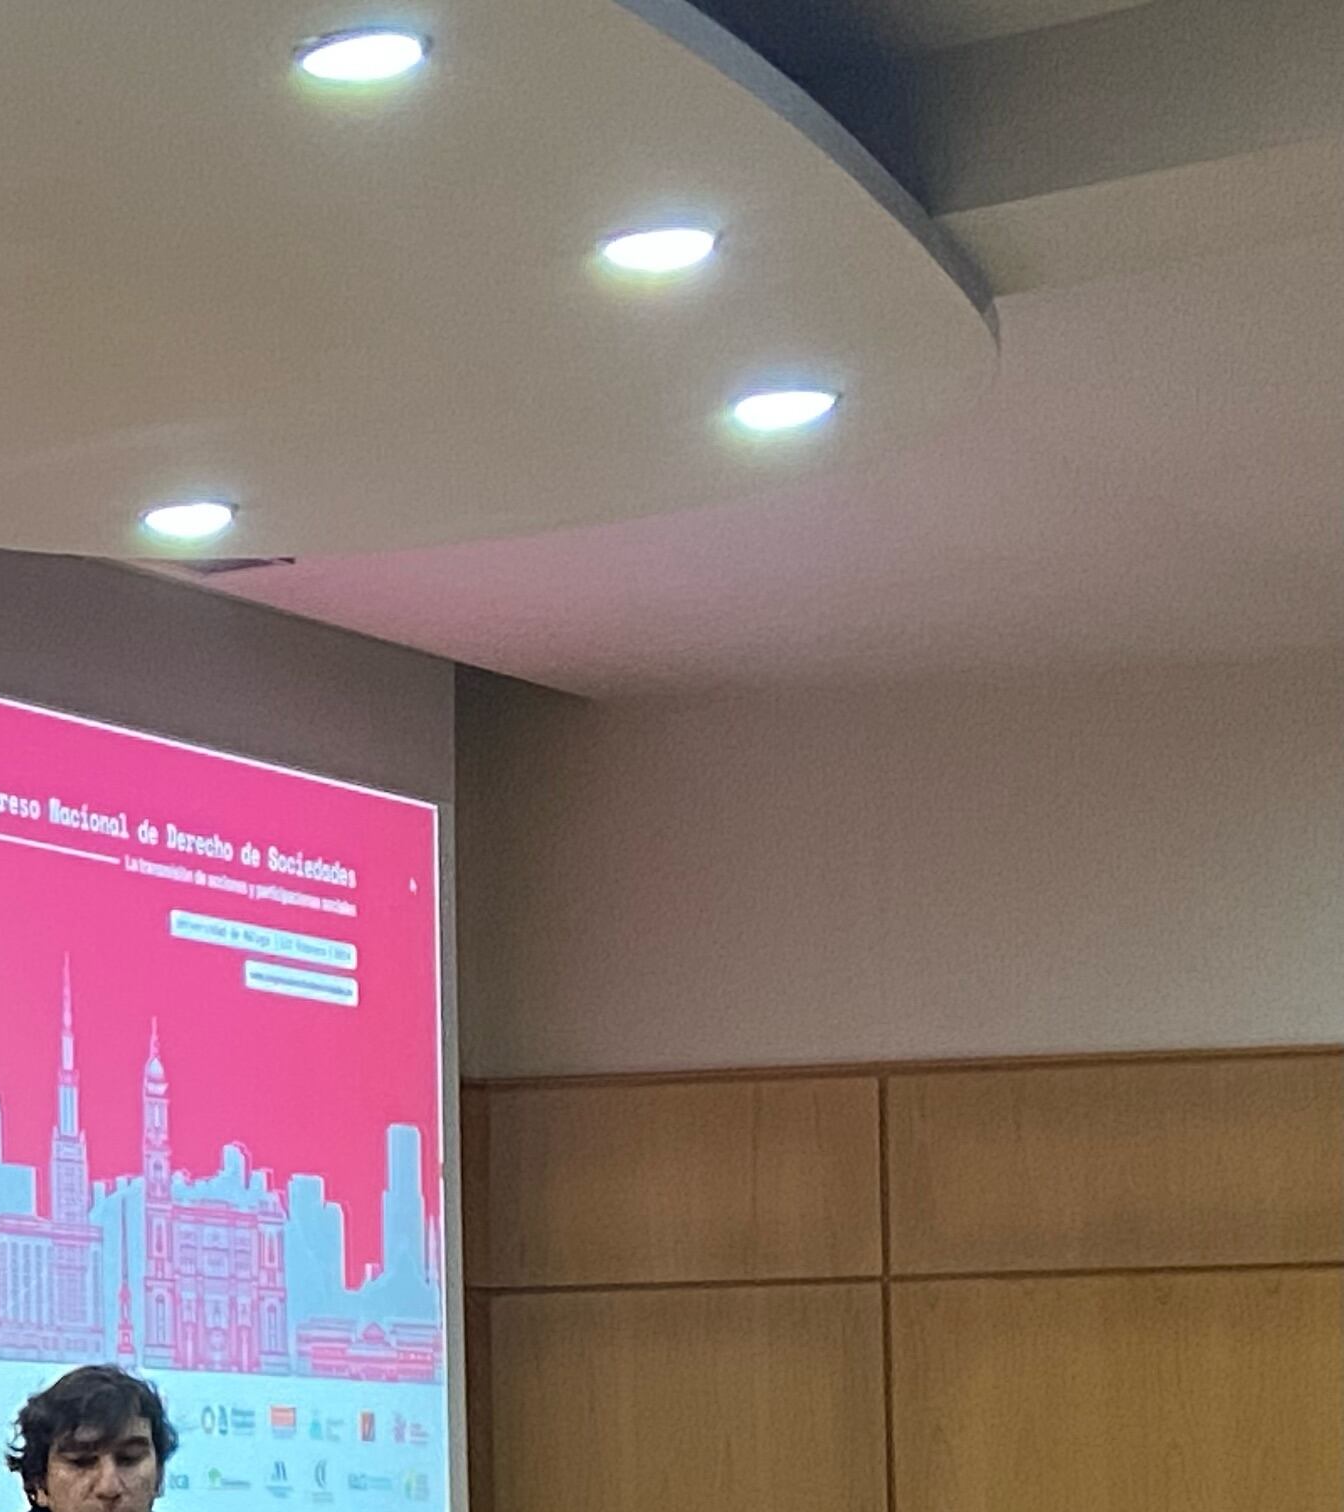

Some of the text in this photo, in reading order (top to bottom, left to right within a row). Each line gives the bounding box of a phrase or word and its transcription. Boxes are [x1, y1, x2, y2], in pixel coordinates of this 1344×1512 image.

[48, 797, 131, 840] Nacional
[137, 819, 159, 845] de
[166, 823, 234, 862] Derecho
[241, 842, 261, 868] de
[267, 845, 357, 889] Sociedades
